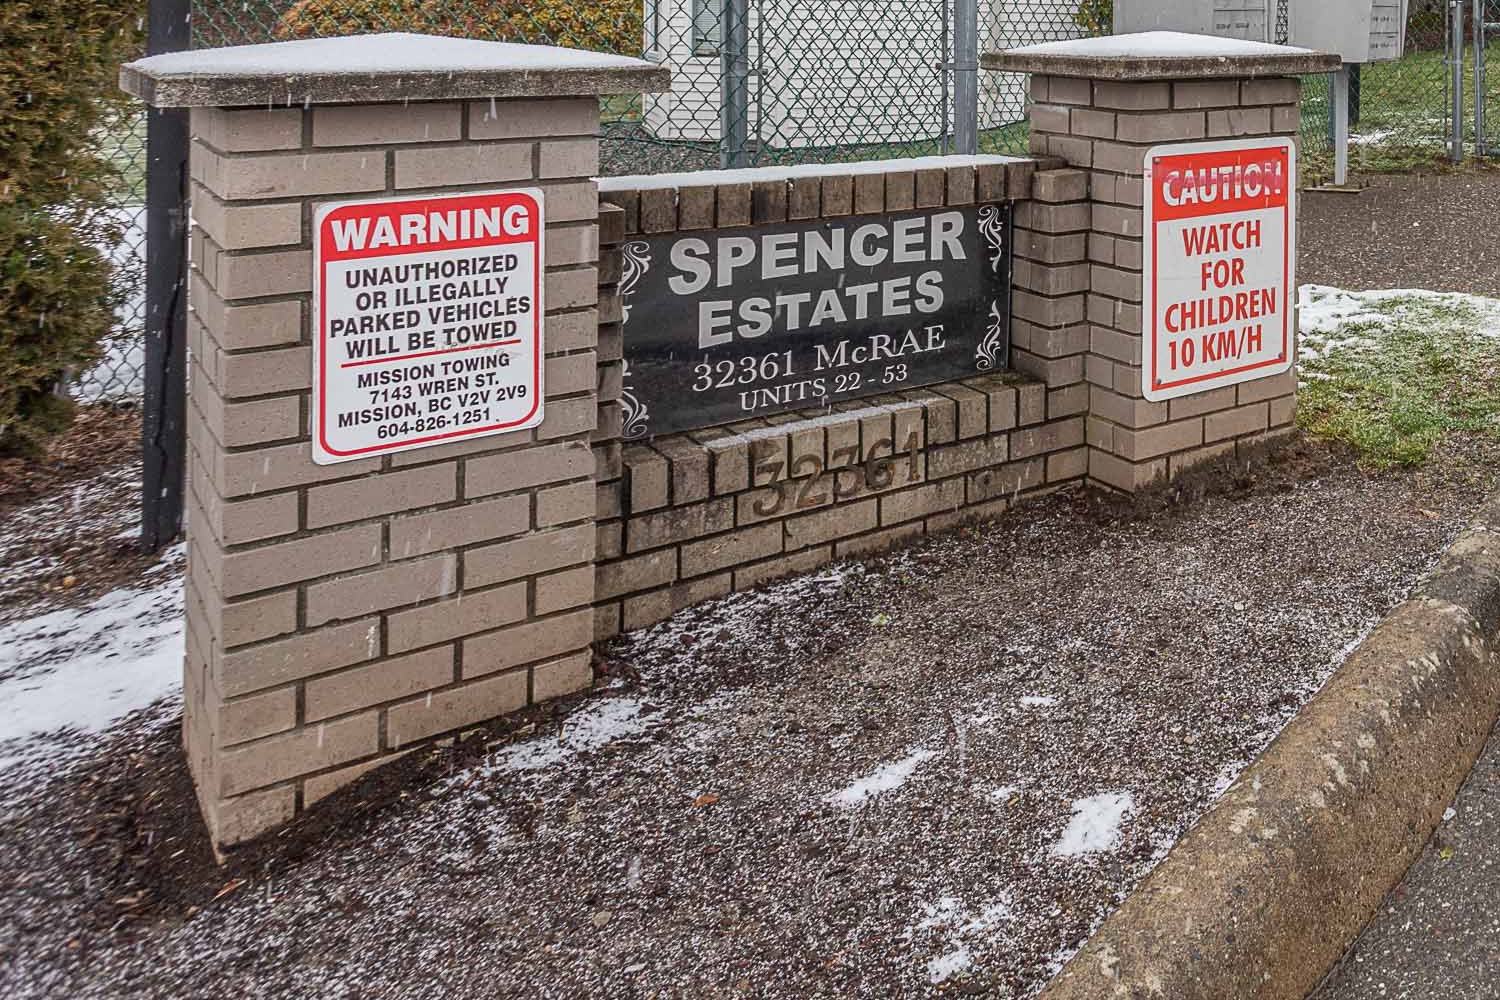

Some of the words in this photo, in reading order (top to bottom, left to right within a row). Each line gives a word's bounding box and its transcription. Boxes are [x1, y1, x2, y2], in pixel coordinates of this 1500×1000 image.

[330, 204, 529, 252] WARNING
[1182, 219, 1261, 257] WATCH
[345, 253, 518, 289] UNAUTHORIZED
[668, 211, 966, 296] SPENCER
[1201, 257, 1244, 291] FOR
[356, 291, 387, 311] OR
[395, 277, 509, 307] ILLEGALLY
[698, 270, 944, 349] ESTATES
[1164, 287, 1276, 333] CHILDREN
[330, 310, 421, 338] PARKED
[428, 296, 531, 325] VEHICLES
[346, 338, 400, 359] WILL
[408, 330, 435, 349] BE
[443, 320, 517, 346] TOWED
[692, 350, 795, 392] 32361
[813, 325, 946, 371] McRAE
[1168, 337, 1195, 371] 10
[1202, 324, 1262, 364] KM/H
[357, 364, 435, 389] MISSION
[441, 353, 510, 376] TOWING
[370, 386, 412, 405] 7143
[418, 378, 470, 397] WREN
[475, 372, 500, 388] ST.
[739, 378, 826, 411] UNITS
[834, 372, 862, 394] 22
[882, 363, 908, 384] 53
[338, 402, 422, 428] MISSION,
[428, 396, 452, 413] BC
[458, 389, 491, 408] V2V
[496, 384, 527, 402] 2V9
[377, 407, 491, 439] 604-826-1251
[753, 431, 921, 516] 32361
